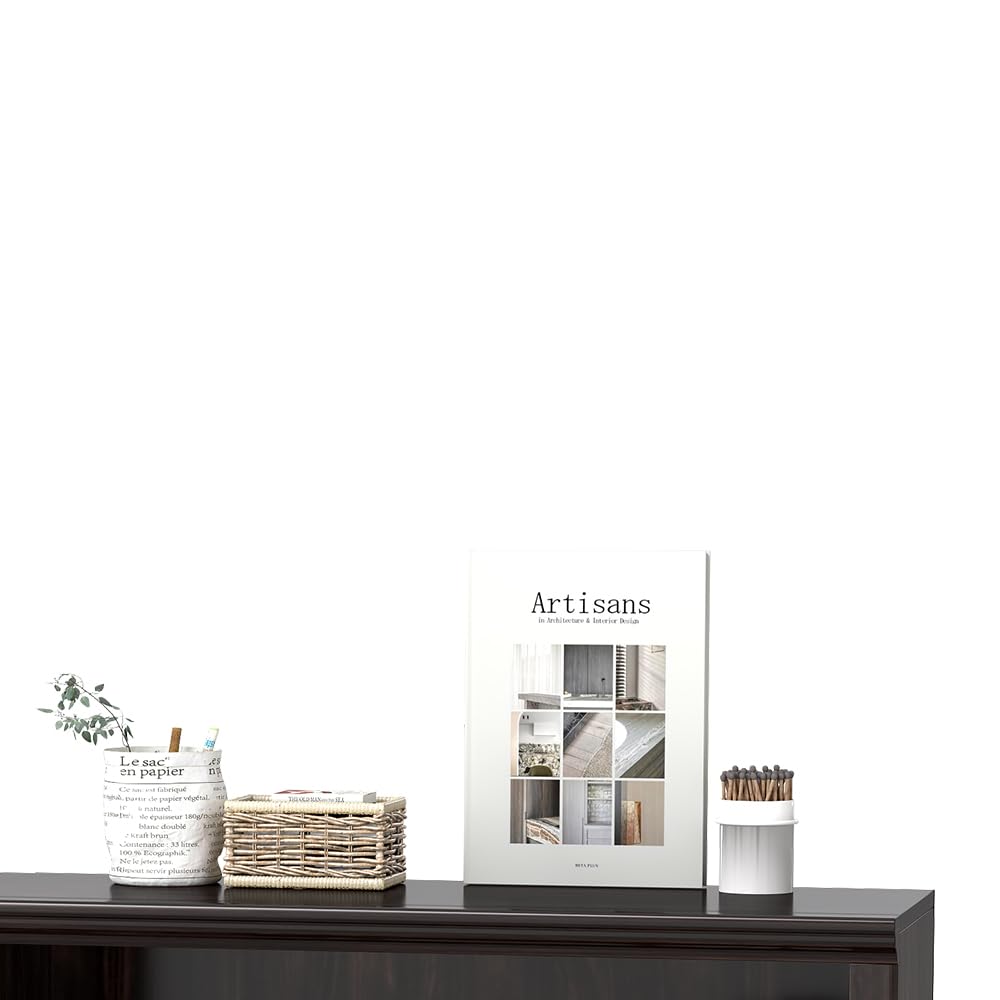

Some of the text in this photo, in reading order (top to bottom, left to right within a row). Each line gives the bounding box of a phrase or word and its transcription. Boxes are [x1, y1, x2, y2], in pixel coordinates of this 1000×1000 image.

[531, 591, 651, 614] Artisans
[538, 616, 545, 624] in
[546, 616, 584, 624] Architecture
[619, 617, 640, 625] Design
[119, 755, 140, 767] Le
[119, 766, 185, 780] en papier
[157, 786, 187, 795] fabriqué
[159, 795, 182, 803] papier
[150, 812, 183, 821] épaisseur
